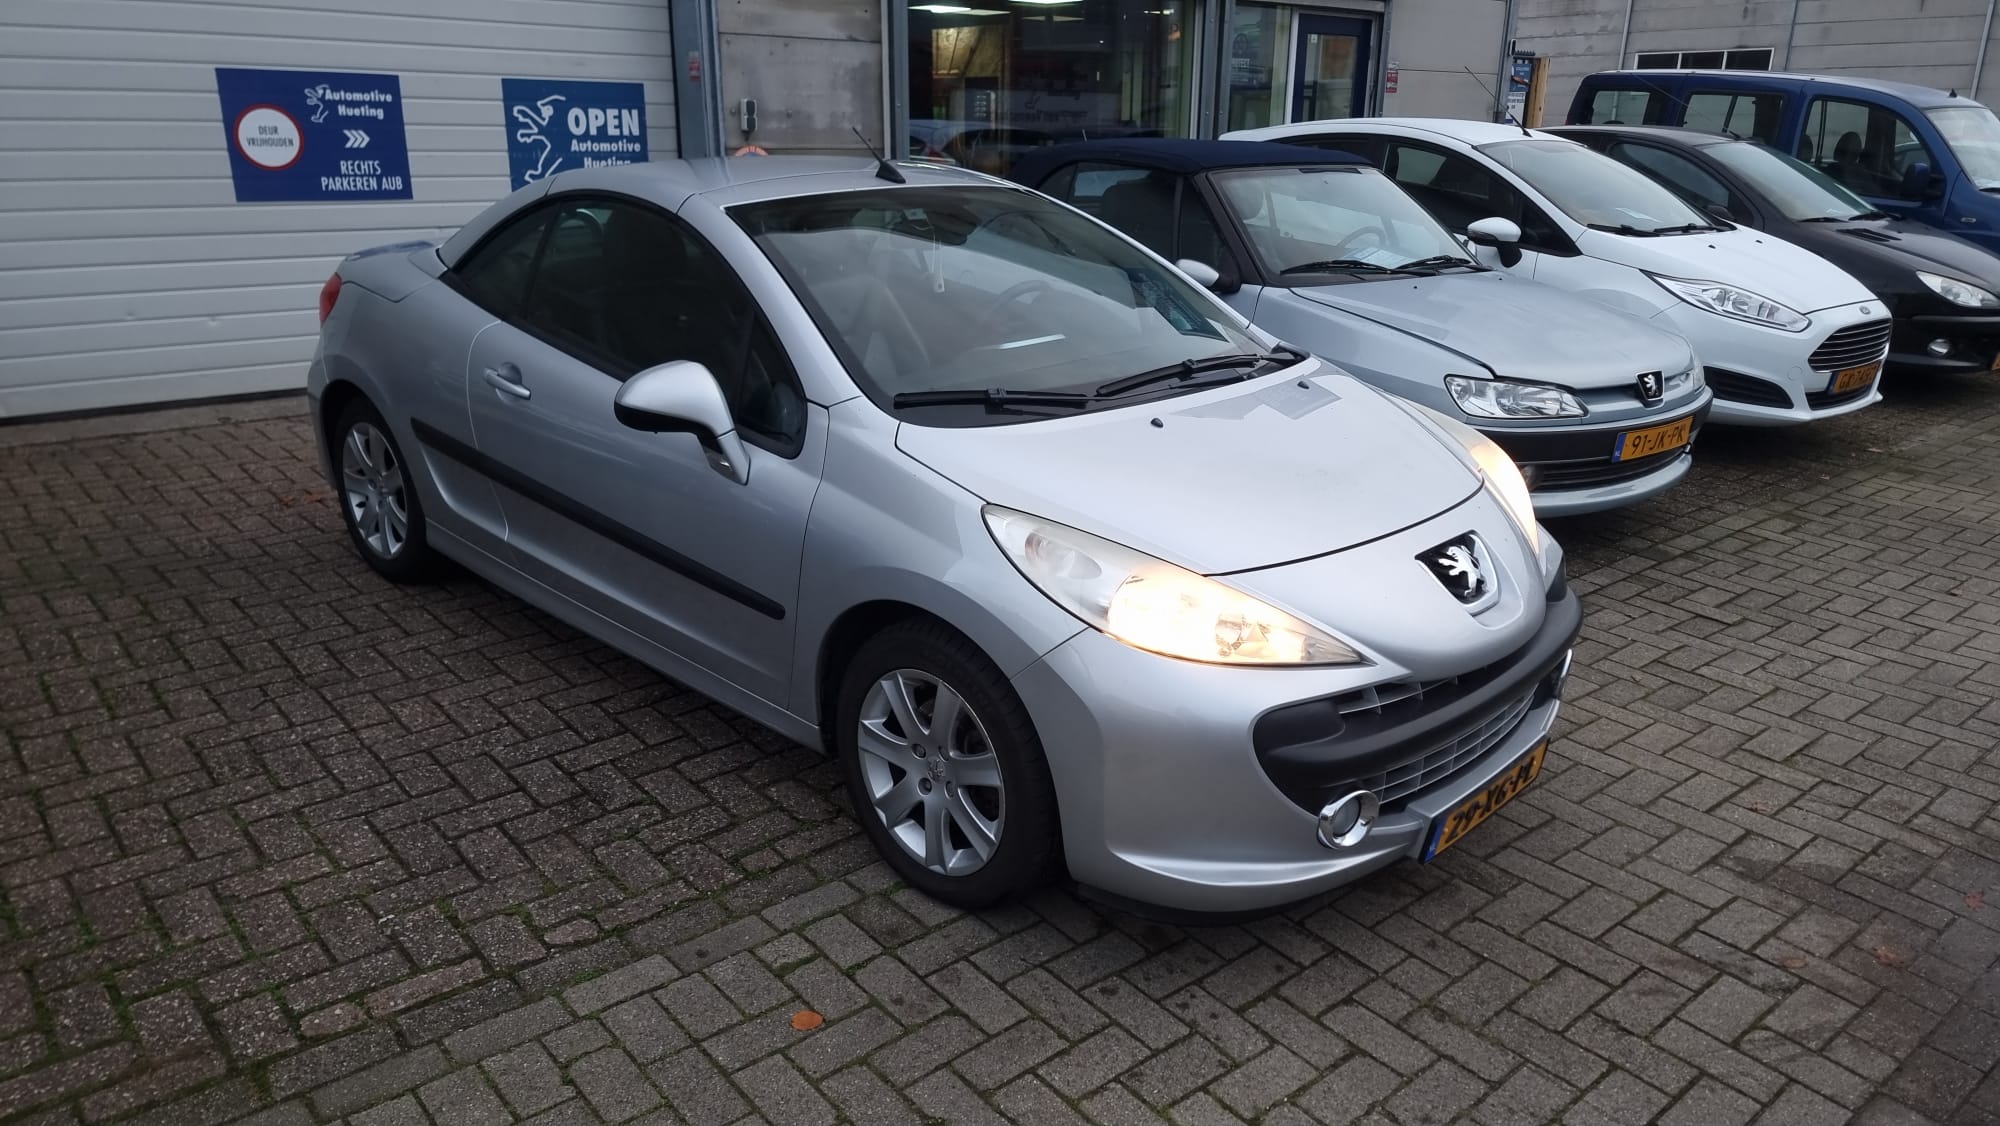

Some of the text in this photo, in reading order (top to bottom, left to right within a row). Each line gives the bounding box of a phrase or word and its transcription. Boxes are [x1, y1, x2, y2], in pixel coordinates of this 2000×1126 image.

[325, 89, 393, 103] Automotive
[338, 104, 385, 120] Hueting
[567, 107, 640, 136] OPEN
[258, 125, 279, 135] DEUR
[570, 139, 641, 152] Automotive
[340, 160, 382, 175] RECHTS
[321, 176, 403, 191] PARKEREN AUB
[1631, 423, 1687, 455] 91-JK-PK
